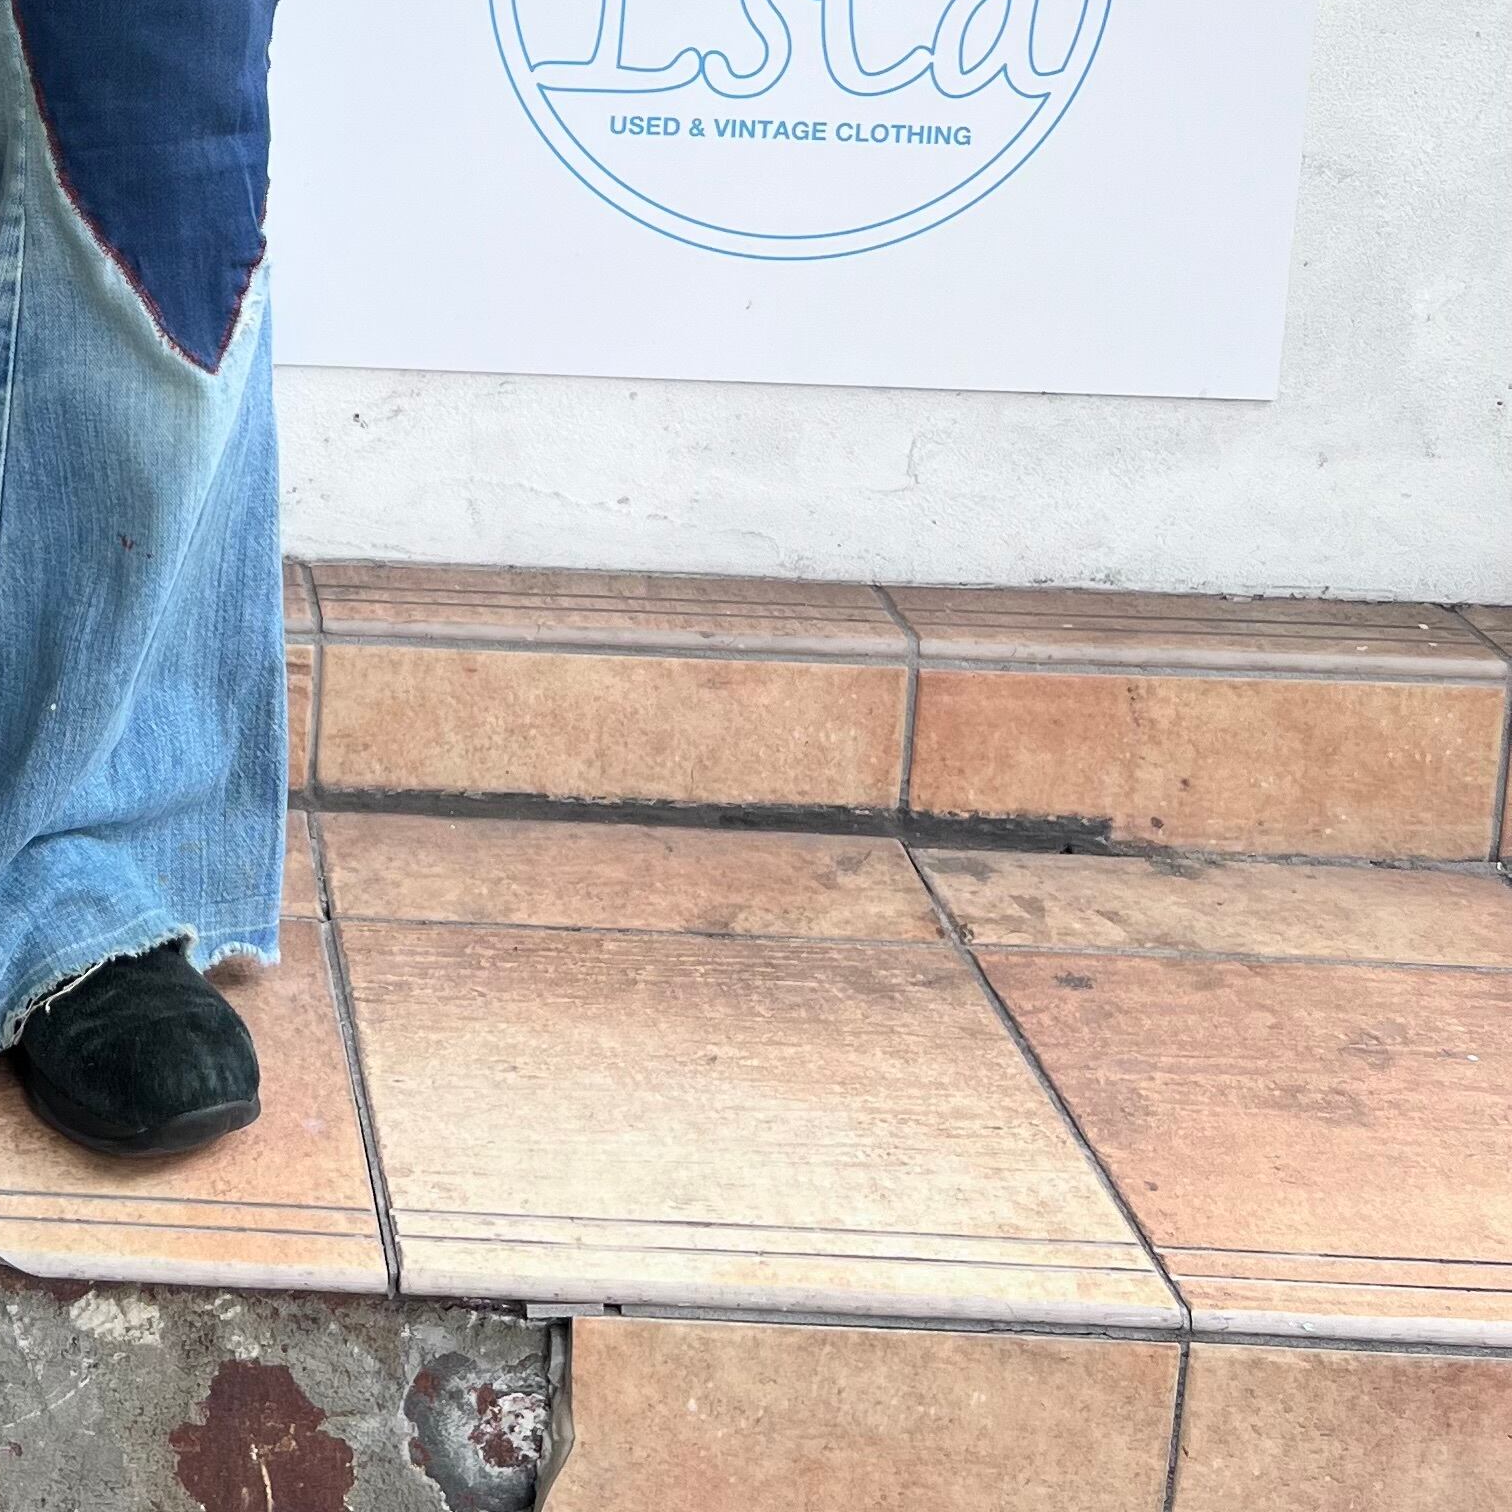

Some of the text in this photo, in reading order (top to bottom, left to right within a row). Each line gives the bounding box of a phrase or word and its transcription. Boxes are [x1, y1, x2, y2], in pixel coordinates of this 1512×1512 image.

[609, 114, 972, 147] USED & VINTAGE CLOTHING
